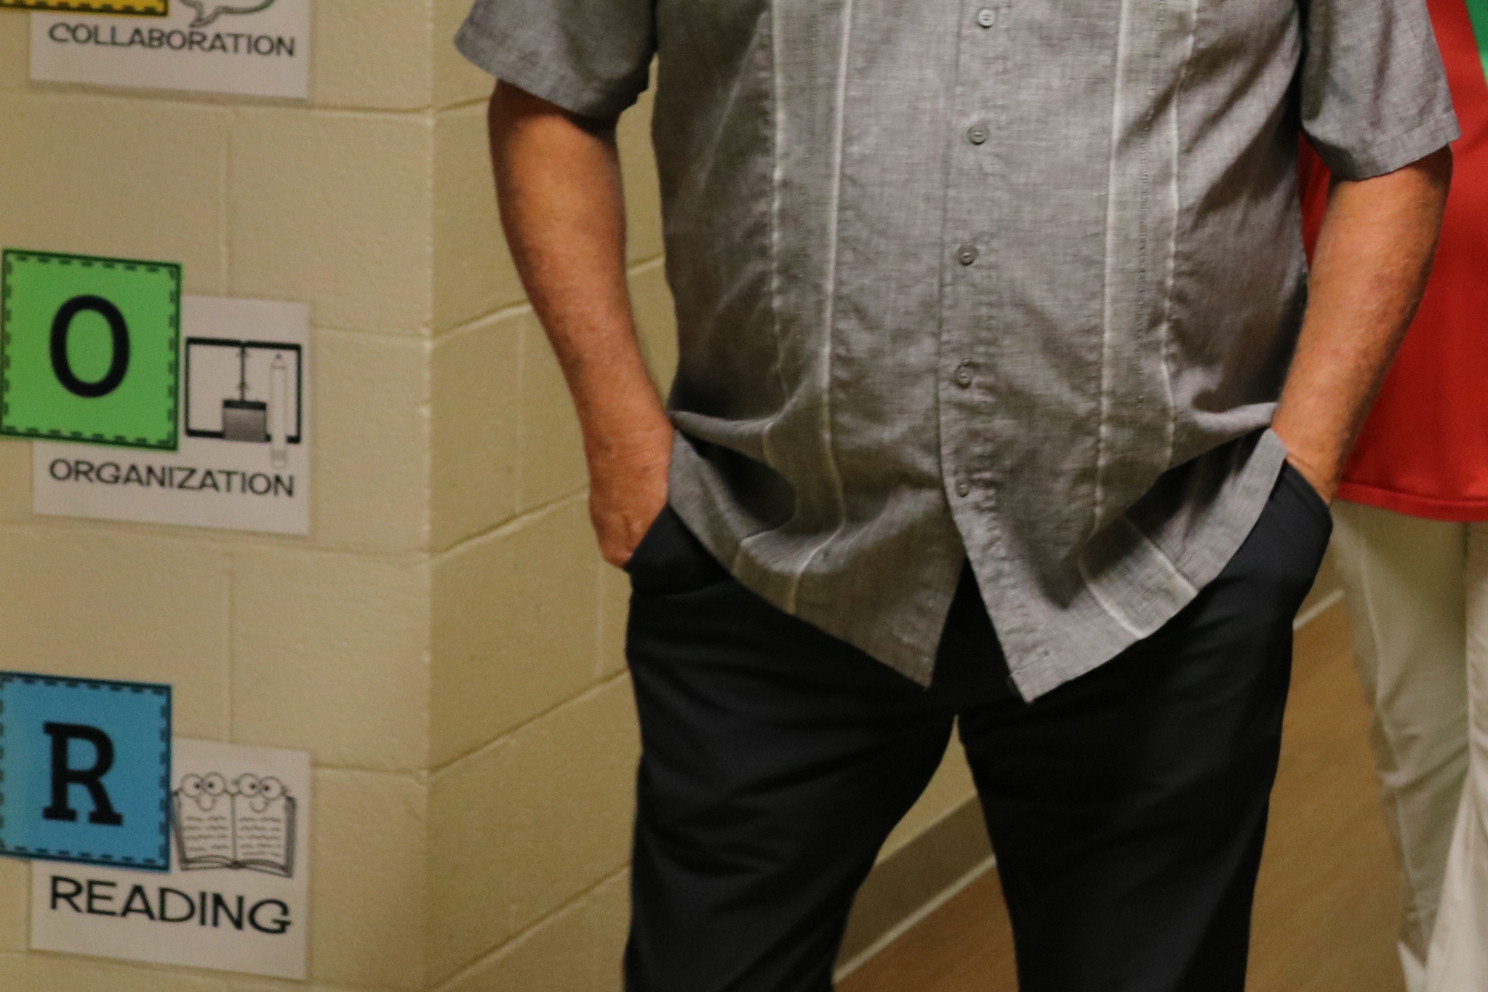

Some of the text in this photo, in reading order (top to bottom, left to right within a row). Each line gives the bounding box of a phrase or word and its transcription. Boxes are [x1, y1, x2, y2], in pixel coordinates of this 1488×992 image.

[48, 21, 296, 58] COLLABORATION
[50, 294, 130, 399] O
[49, 458, 295, 497] ORGANIZATION
[42, 721, 124, 827] R
[50, 874, 292, 935] READING
